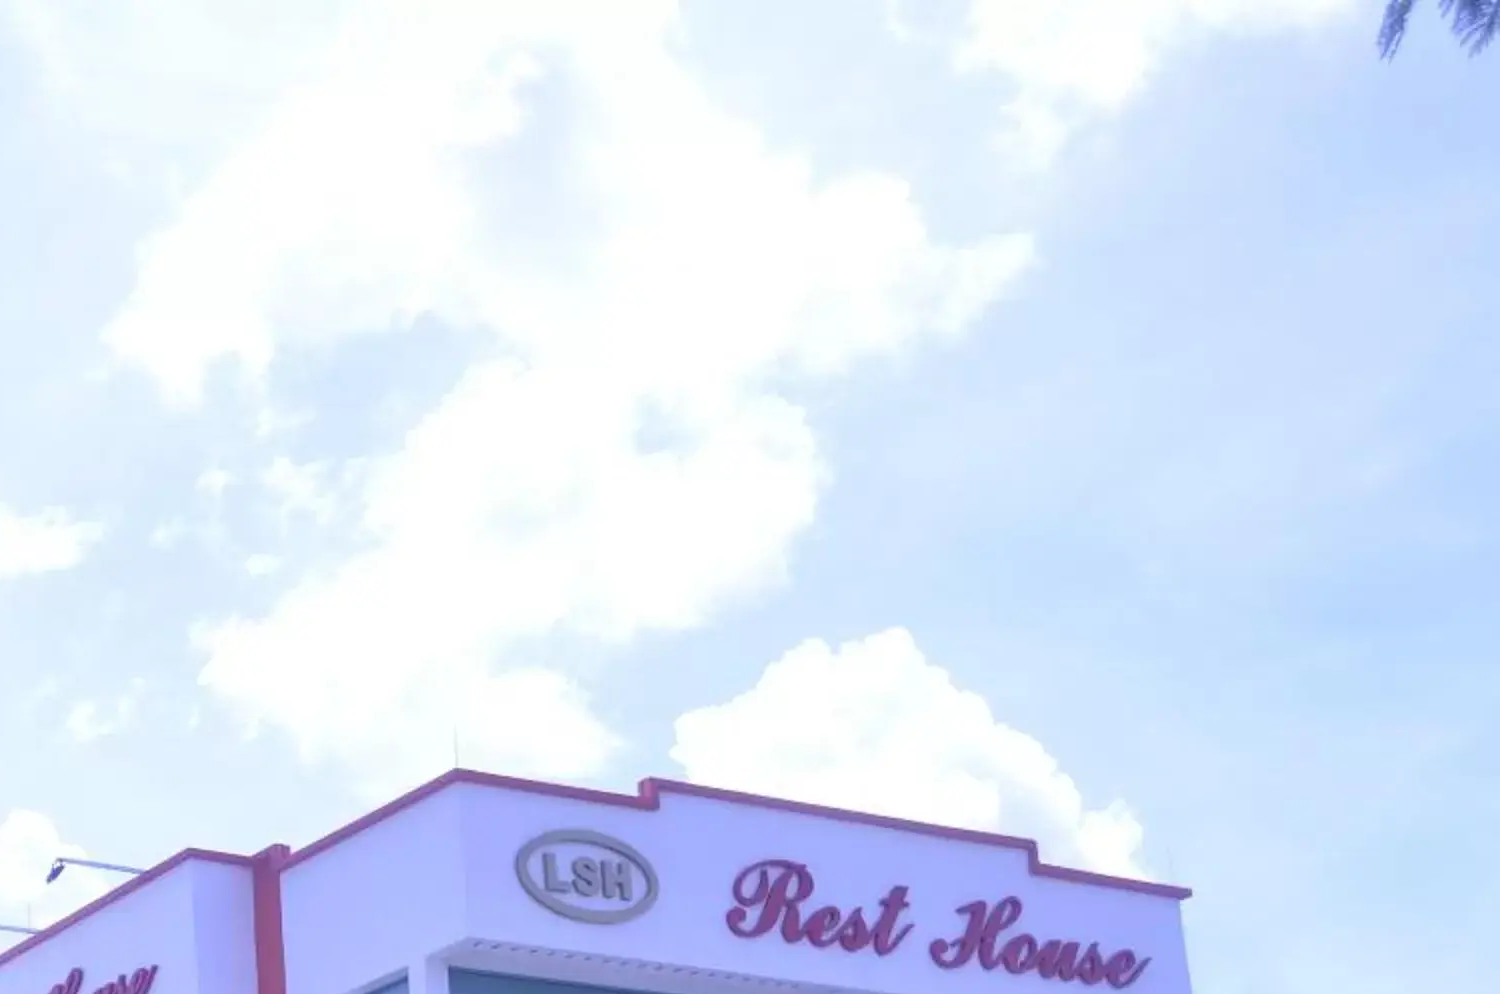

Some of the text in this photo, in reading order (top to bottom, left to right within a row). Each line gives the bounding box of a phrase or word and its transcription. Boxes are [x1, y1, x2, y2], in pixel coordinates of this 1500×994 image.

[541, 850, 632, 902] LSH
[726, 859, 1152, 989] Rest House
